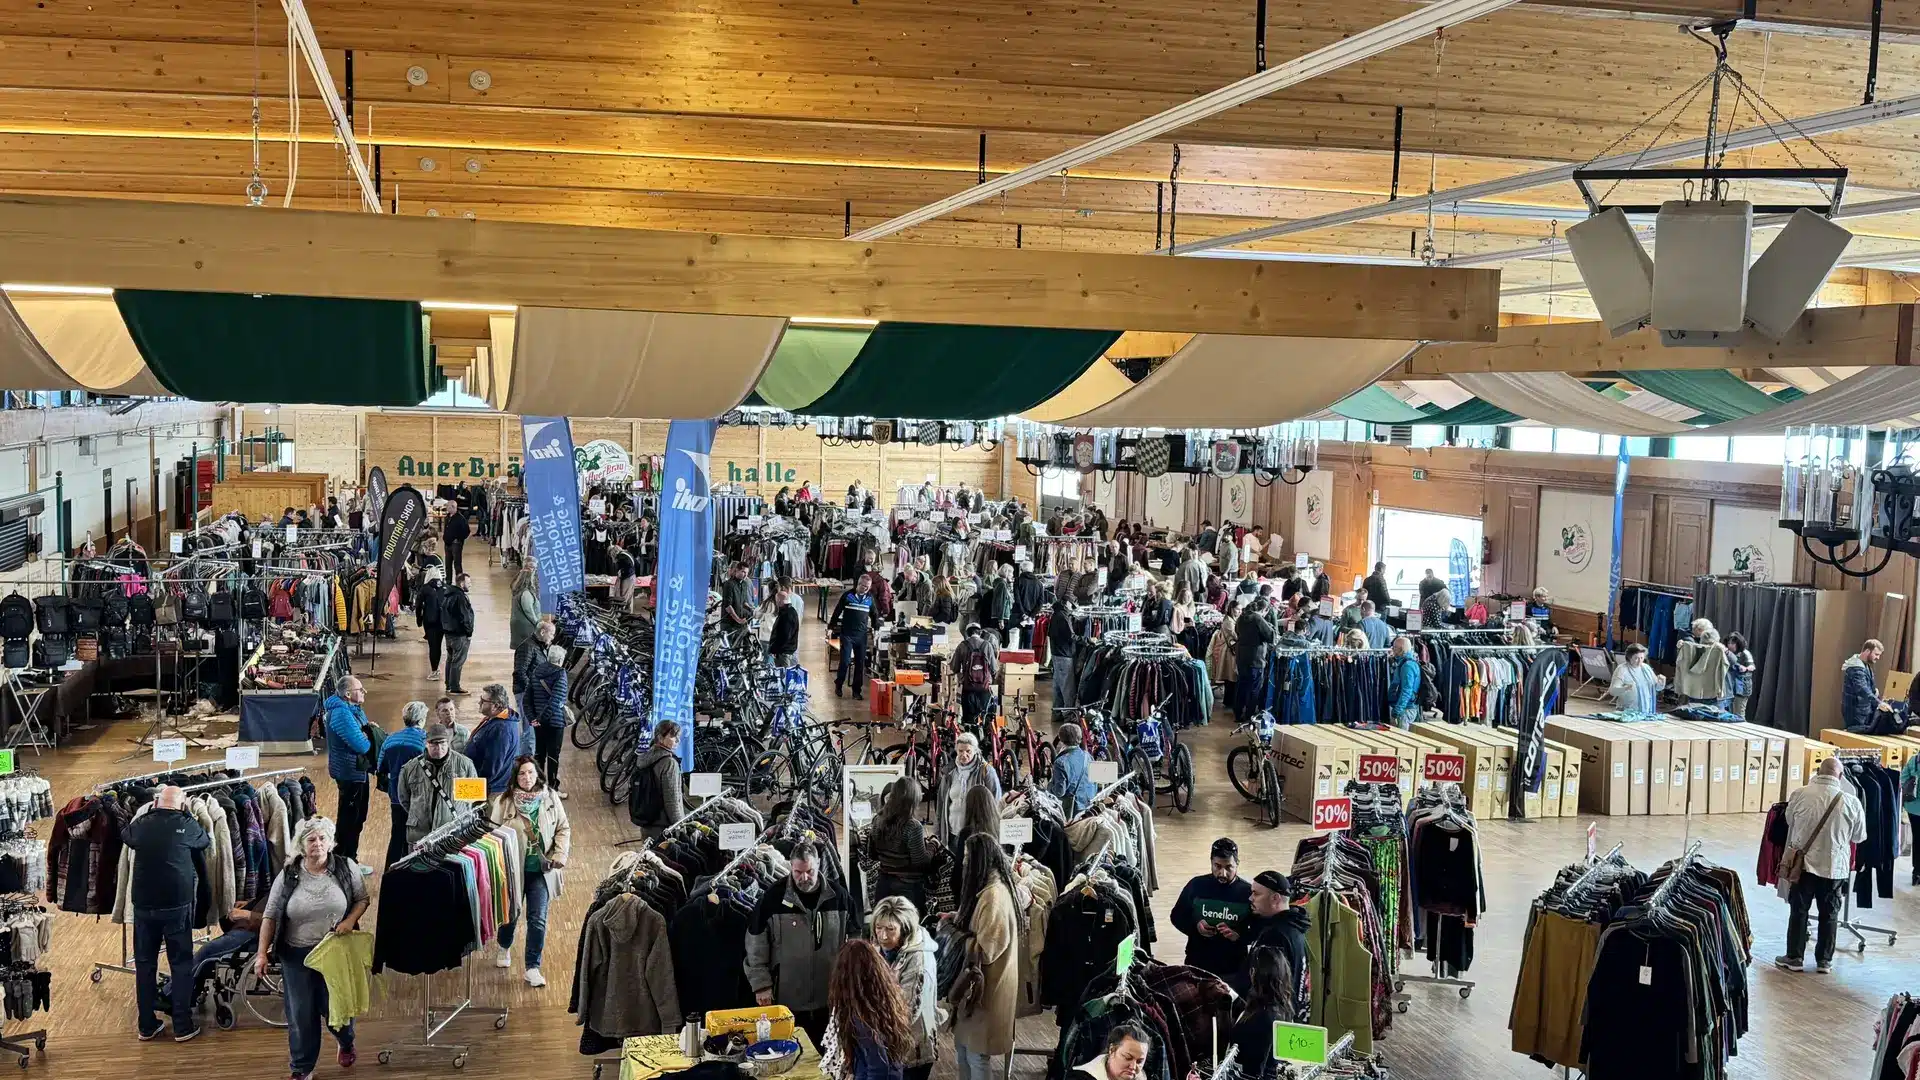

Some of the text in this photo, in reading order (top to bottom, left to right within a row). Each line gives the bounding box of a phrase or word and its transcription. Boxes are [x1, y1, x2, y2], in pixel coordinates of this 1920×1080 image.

[397, 455, 797, 483] AuerBrä halle
[383, 519, 406, 560] MOUNTAIN
[400, 499, 415, 521] SHOP
[669, 573, 685, 592] &
[663, 598, 693, 717] IKESPORT
[1362, 761, 1397, 778] 50%
[1426, 760, 1461, 777] 50%
[1315, 804, 1348, 824] 50%
